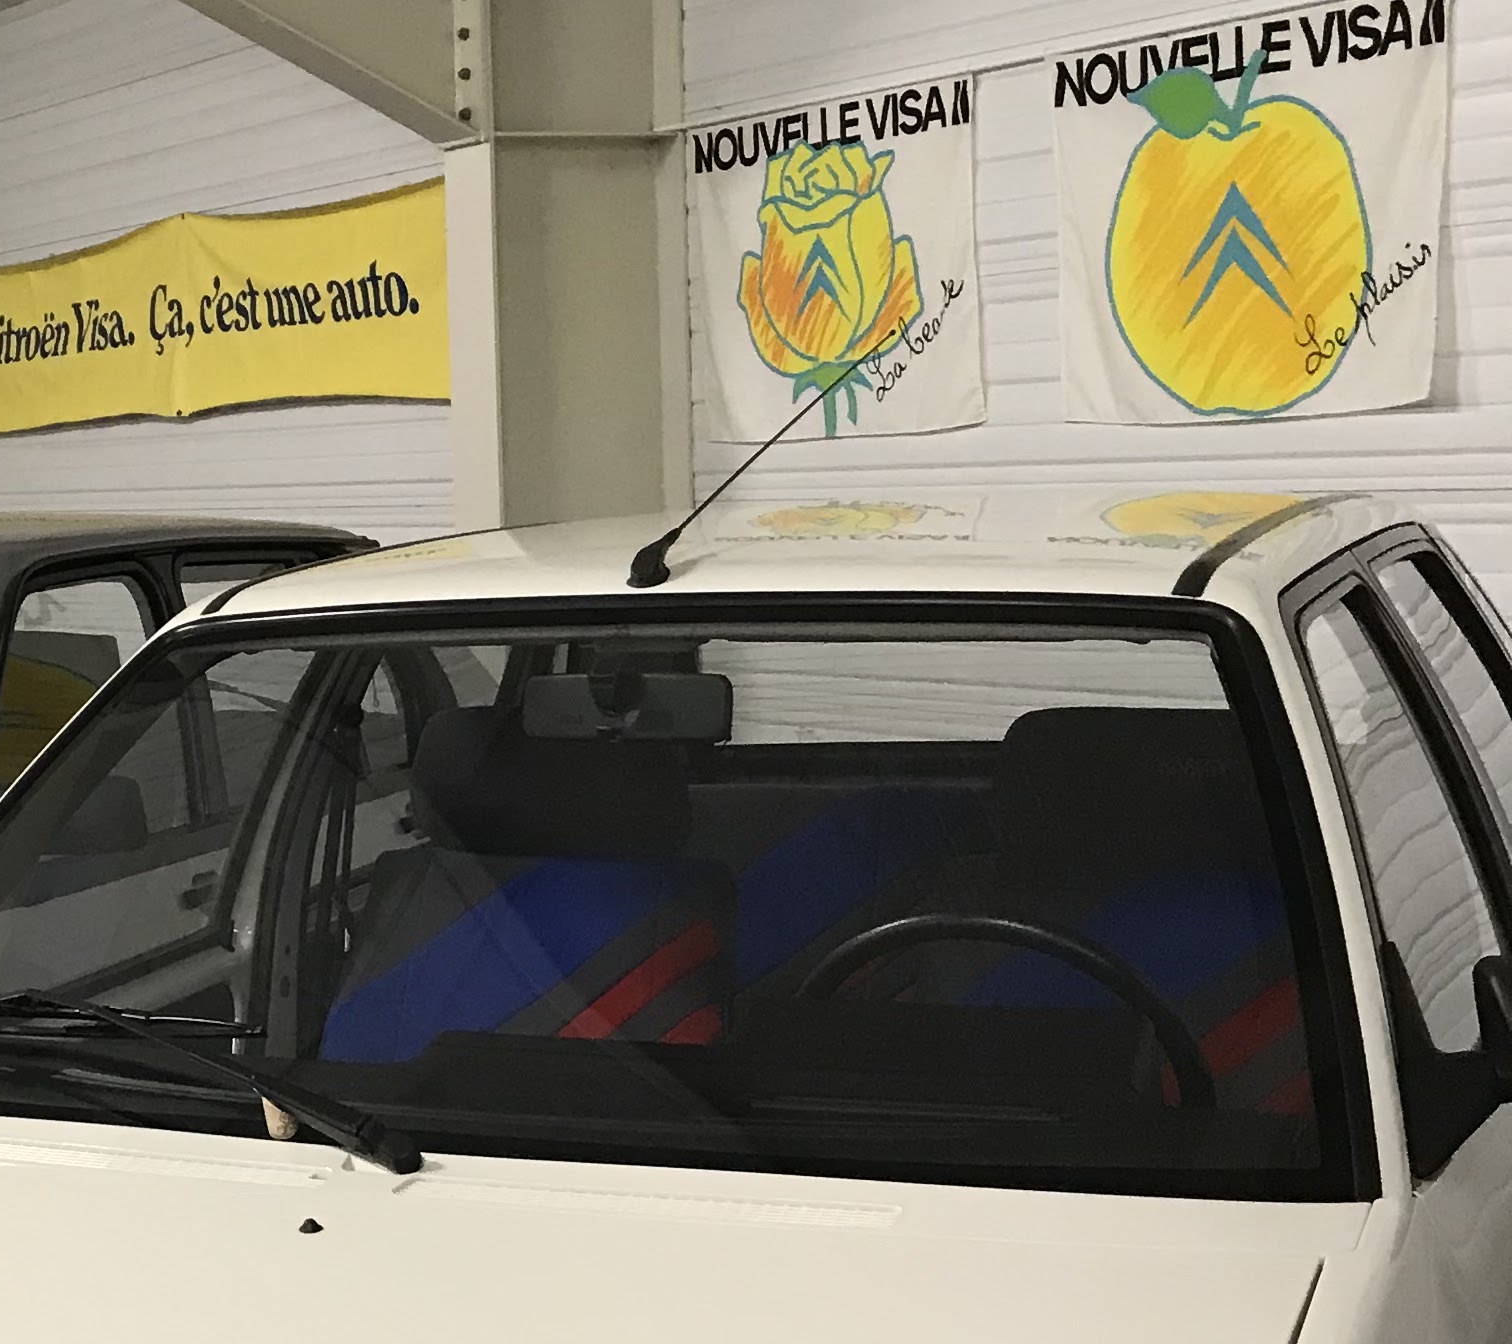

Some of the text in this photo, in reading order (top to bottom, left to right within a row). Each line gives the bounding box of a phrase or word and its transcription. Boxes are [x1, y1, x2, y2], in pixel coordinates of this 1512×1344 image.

[1054, 18, 1292, 108] NOUVELLE
[1298, 0, 1413, 68] VISA
[692, 101, 861, 174] NOUVELLE
[865, 86, 947, 140] VISA
[71, 298, 135, 354] Visa.
[149, 284, 195, 356] Ça,
[199, 275, 262, 335] c'est
[263, 281, 325, 327] une
[326, 260, 420, 323] auto.
[1293, 313, 1348, 375] Le
[866, 347, 907, 403] La
